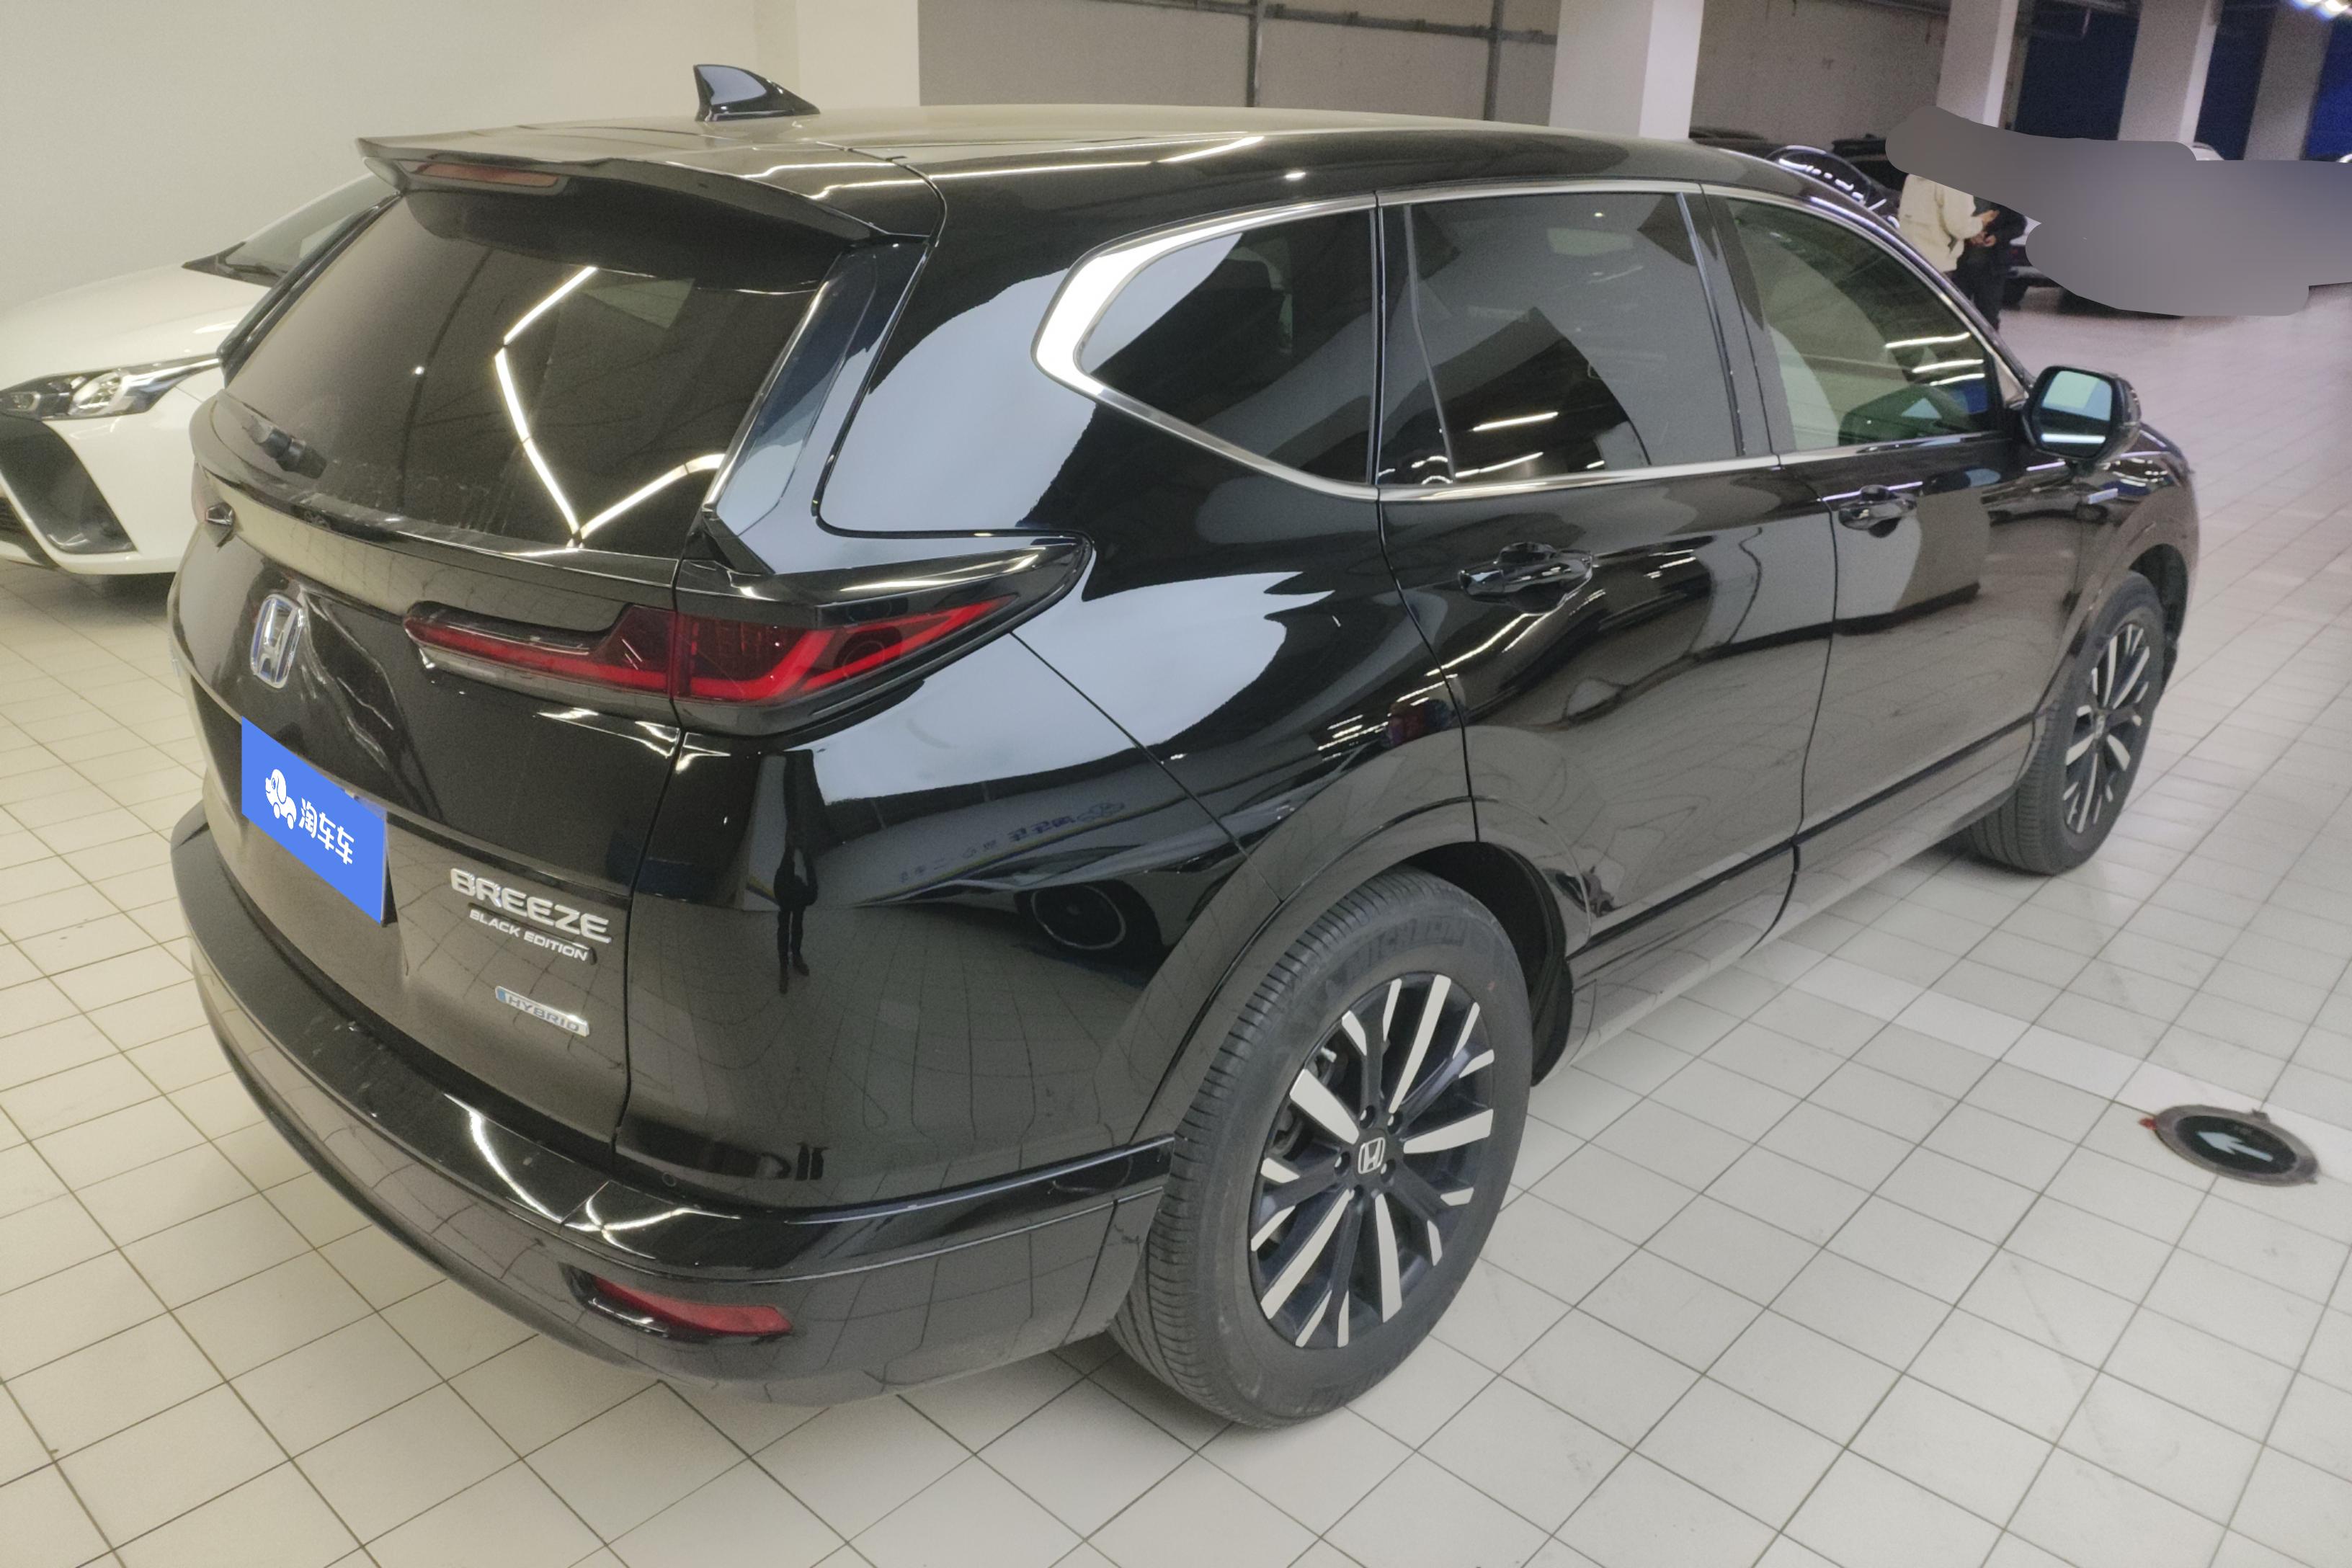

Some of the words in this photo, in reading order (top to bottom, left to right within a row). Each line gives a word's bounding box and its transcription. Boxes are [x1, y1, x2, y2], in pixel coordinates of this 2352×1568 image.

[450, 868, 612, 944] BREEZE
[469, 909, 521, 937] BLACK
[523, 930, 589, 962] EDITION
[507, 995, 579, 1032] HYBRID
